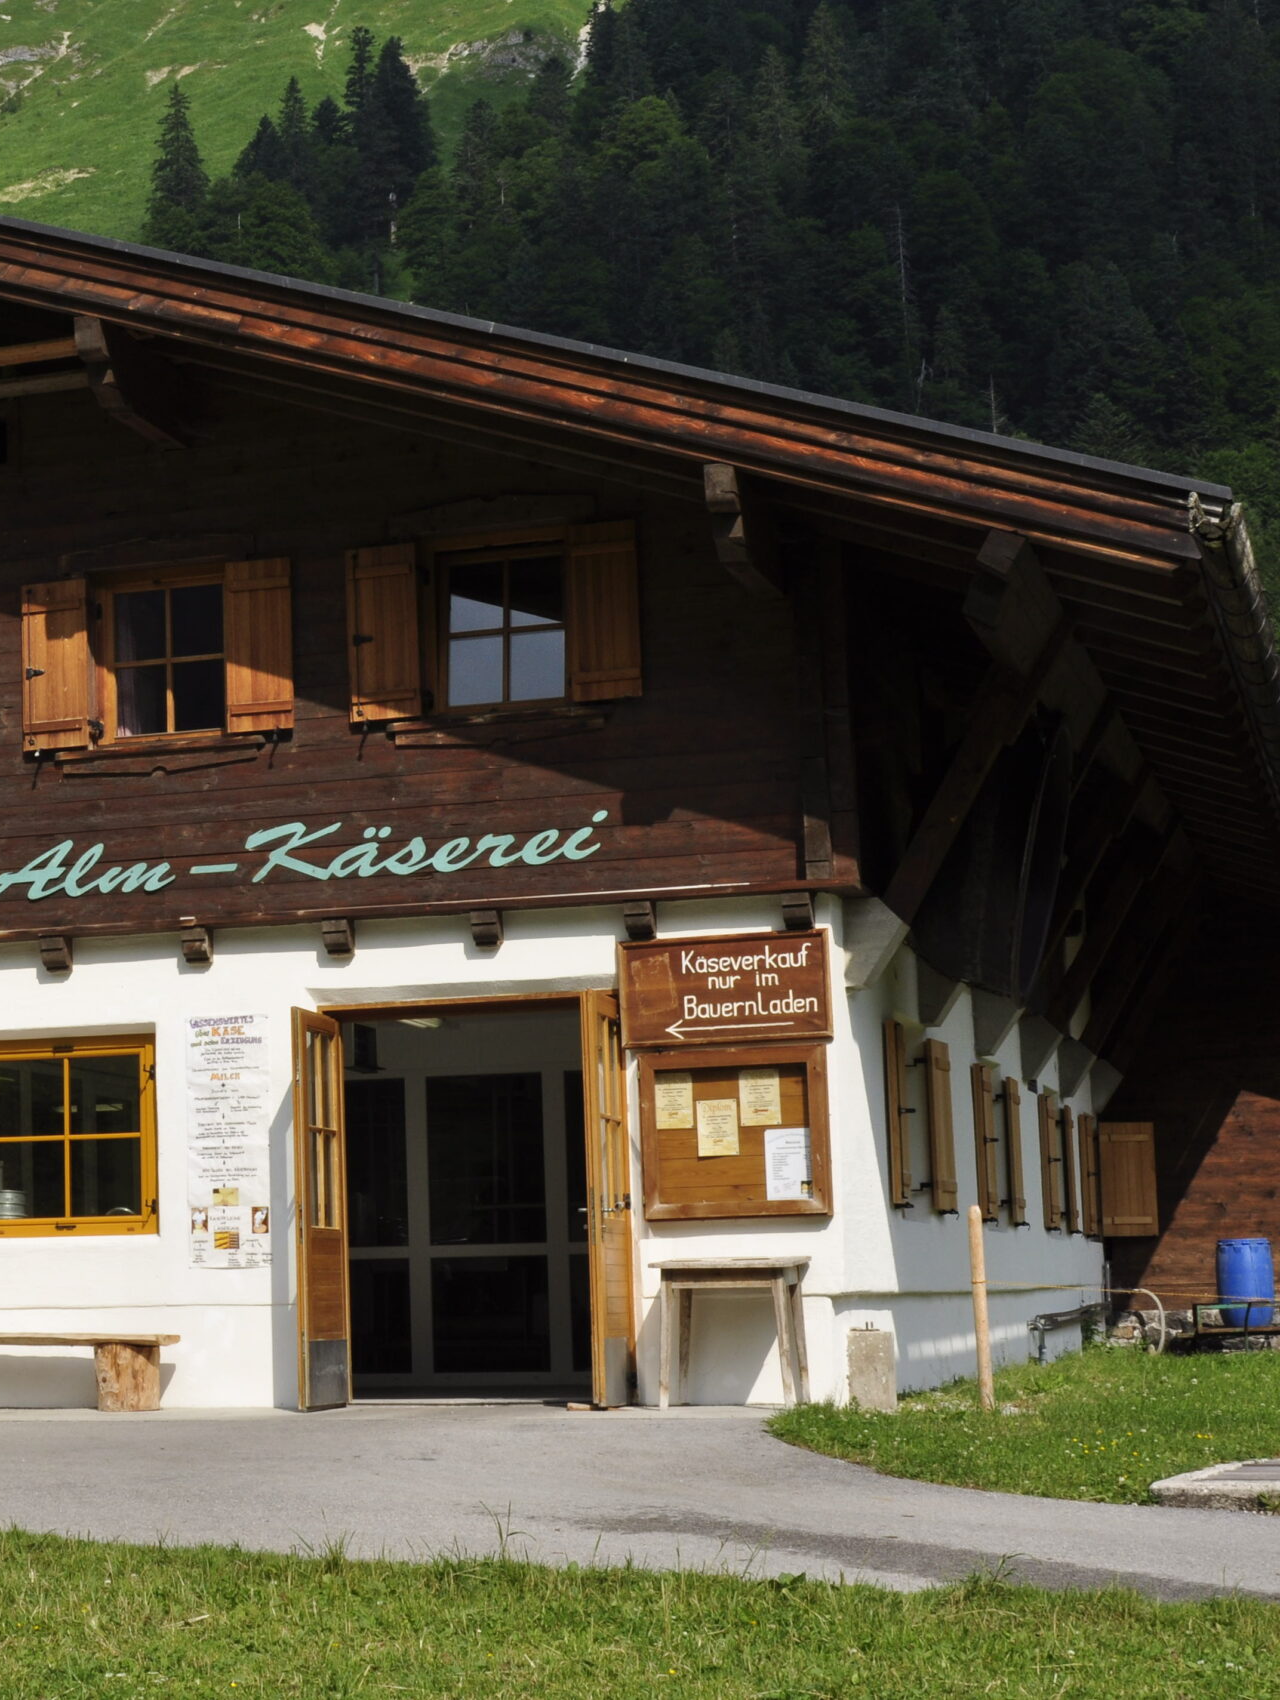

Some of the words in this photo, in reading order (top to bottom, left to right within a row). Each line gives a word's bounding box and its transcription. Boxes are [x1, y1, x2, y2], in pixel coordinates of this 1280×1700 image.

[245, 809, 608, 883] Käserei
[681, 943, 812, 974] Käseverkauf
[708, 975, 741, 990] nur
[755, 971, 779, 987] im
